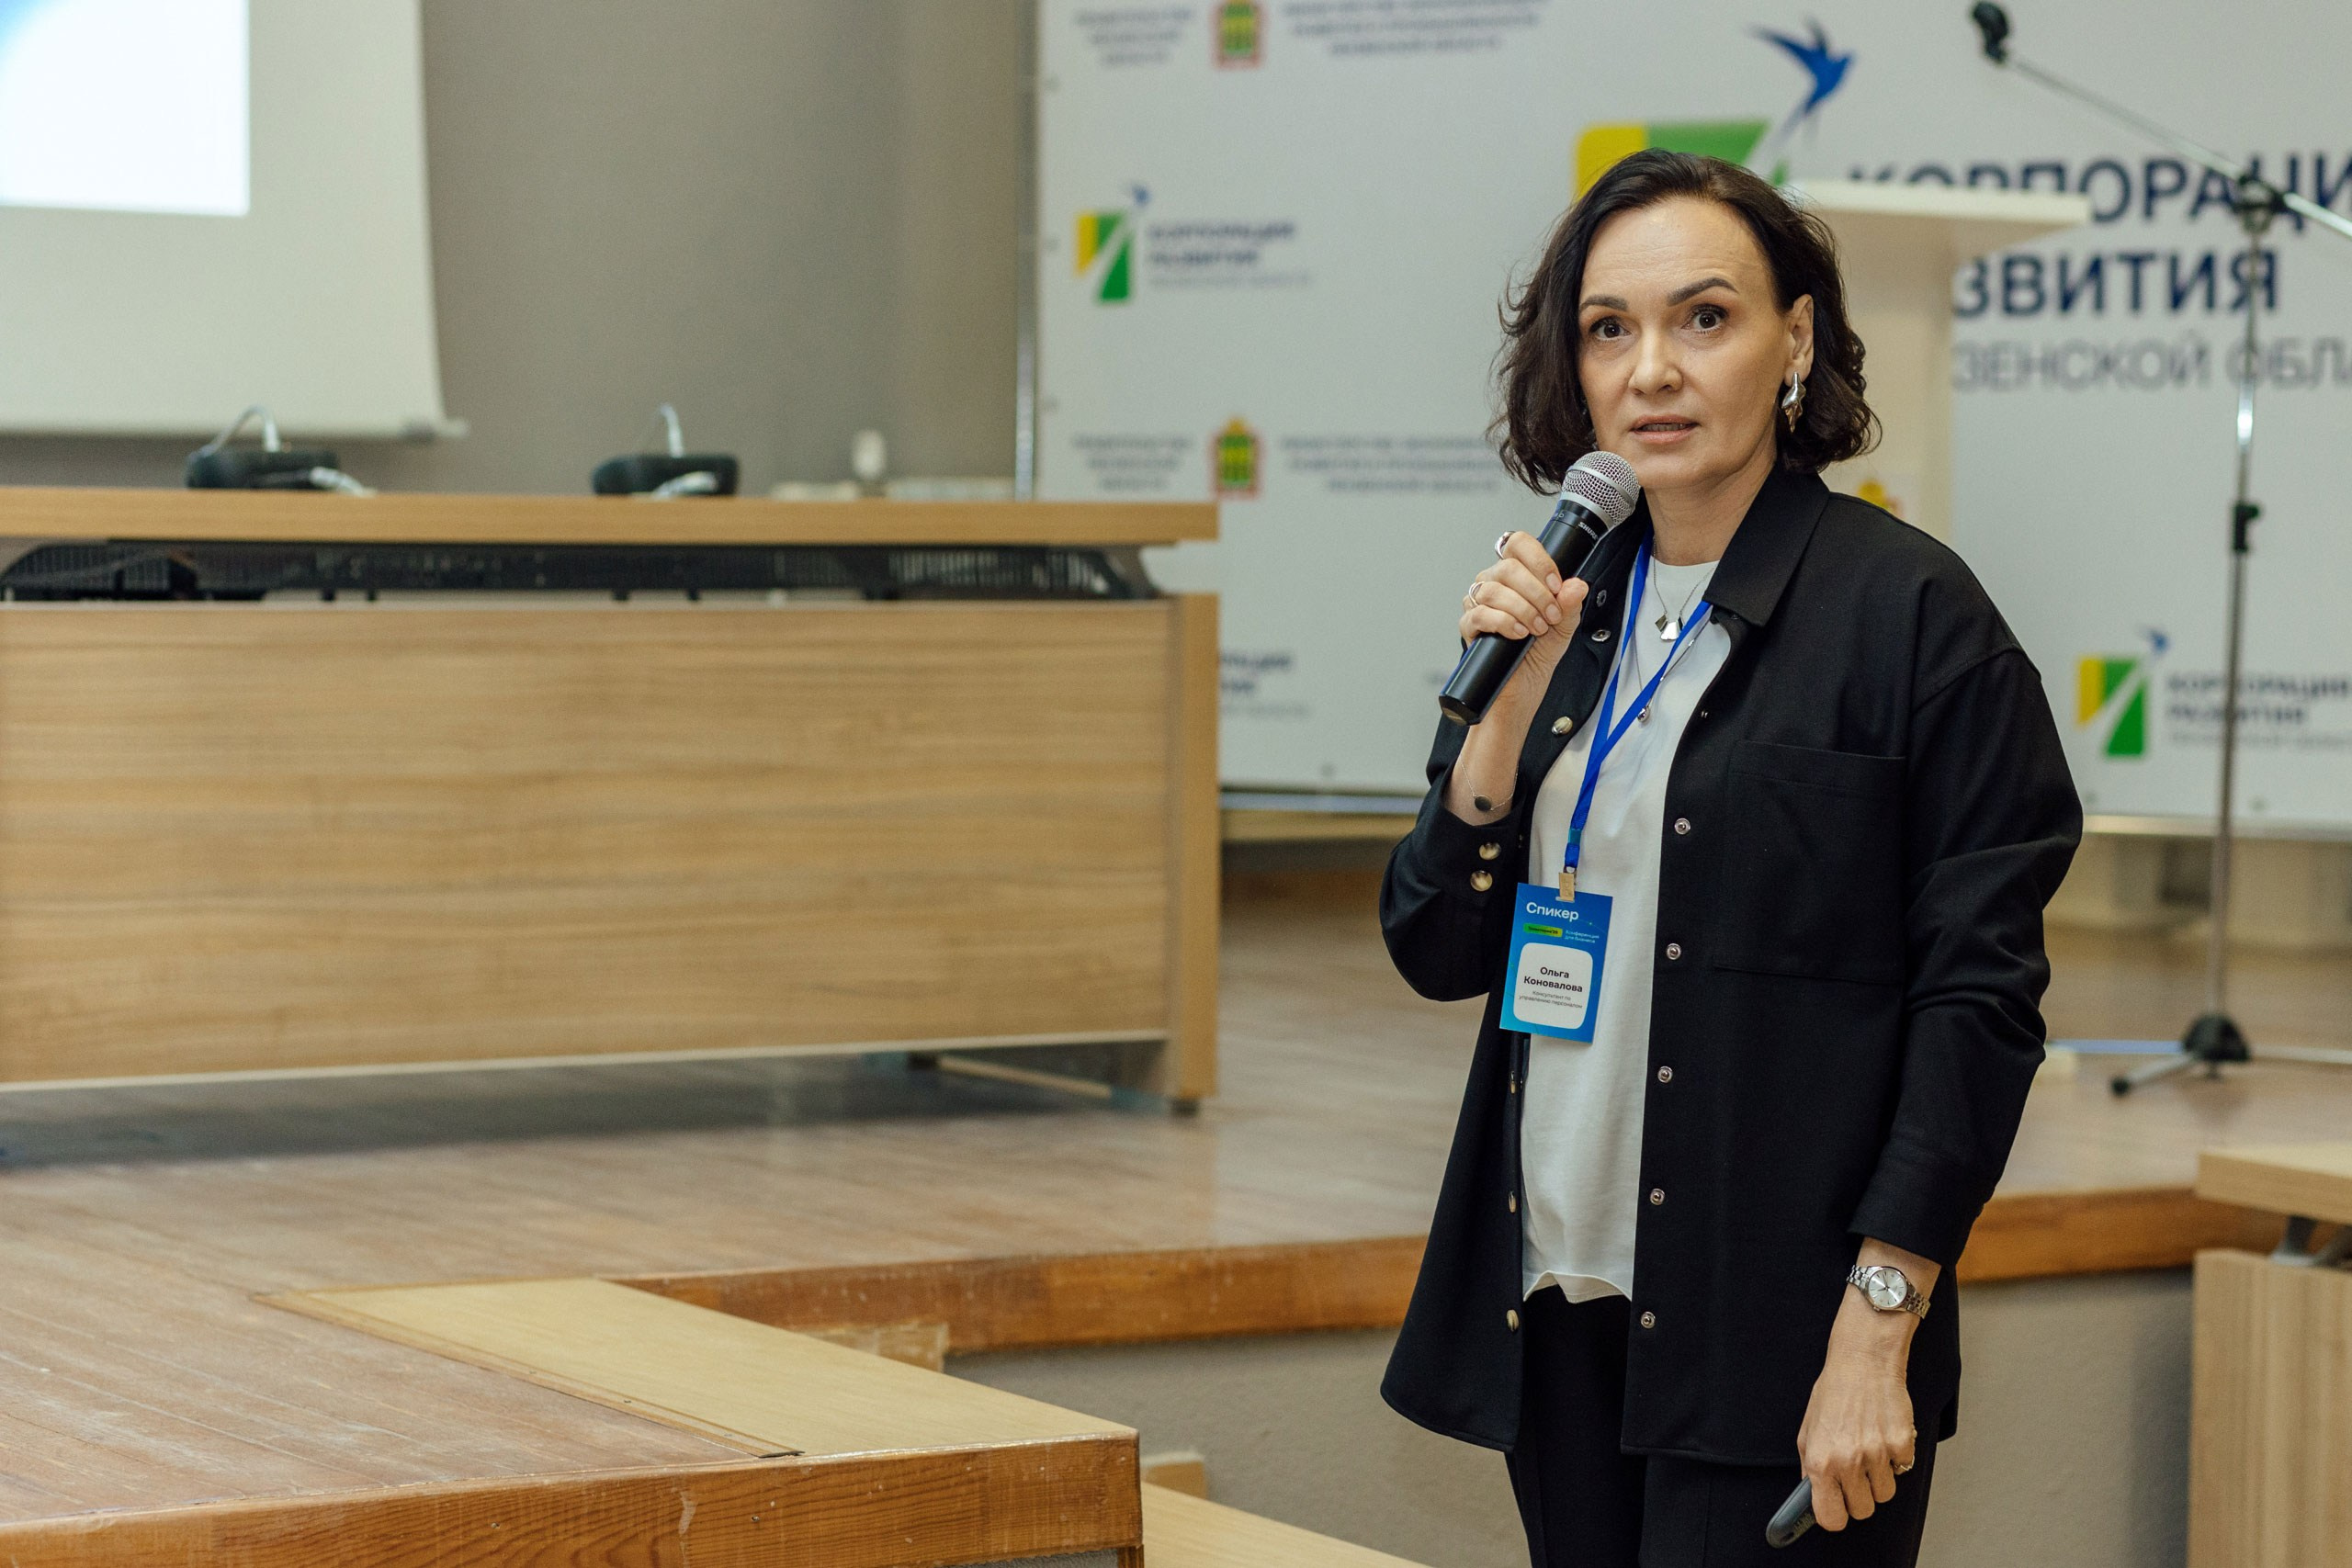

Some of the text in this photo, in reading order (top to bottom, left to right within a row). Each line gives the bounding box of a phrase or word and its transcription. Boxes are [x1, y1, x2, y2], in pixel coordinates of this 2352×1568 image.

[2224, 336, 2352, 389] ОБЛ
[1526, 901, 1579, 923] Спикер
[1540, 966, 1570, 979] Ольга
[1523, 976, 1583, 993] Коновалова
[1551, 1000, 1583, 1010] персоналом
